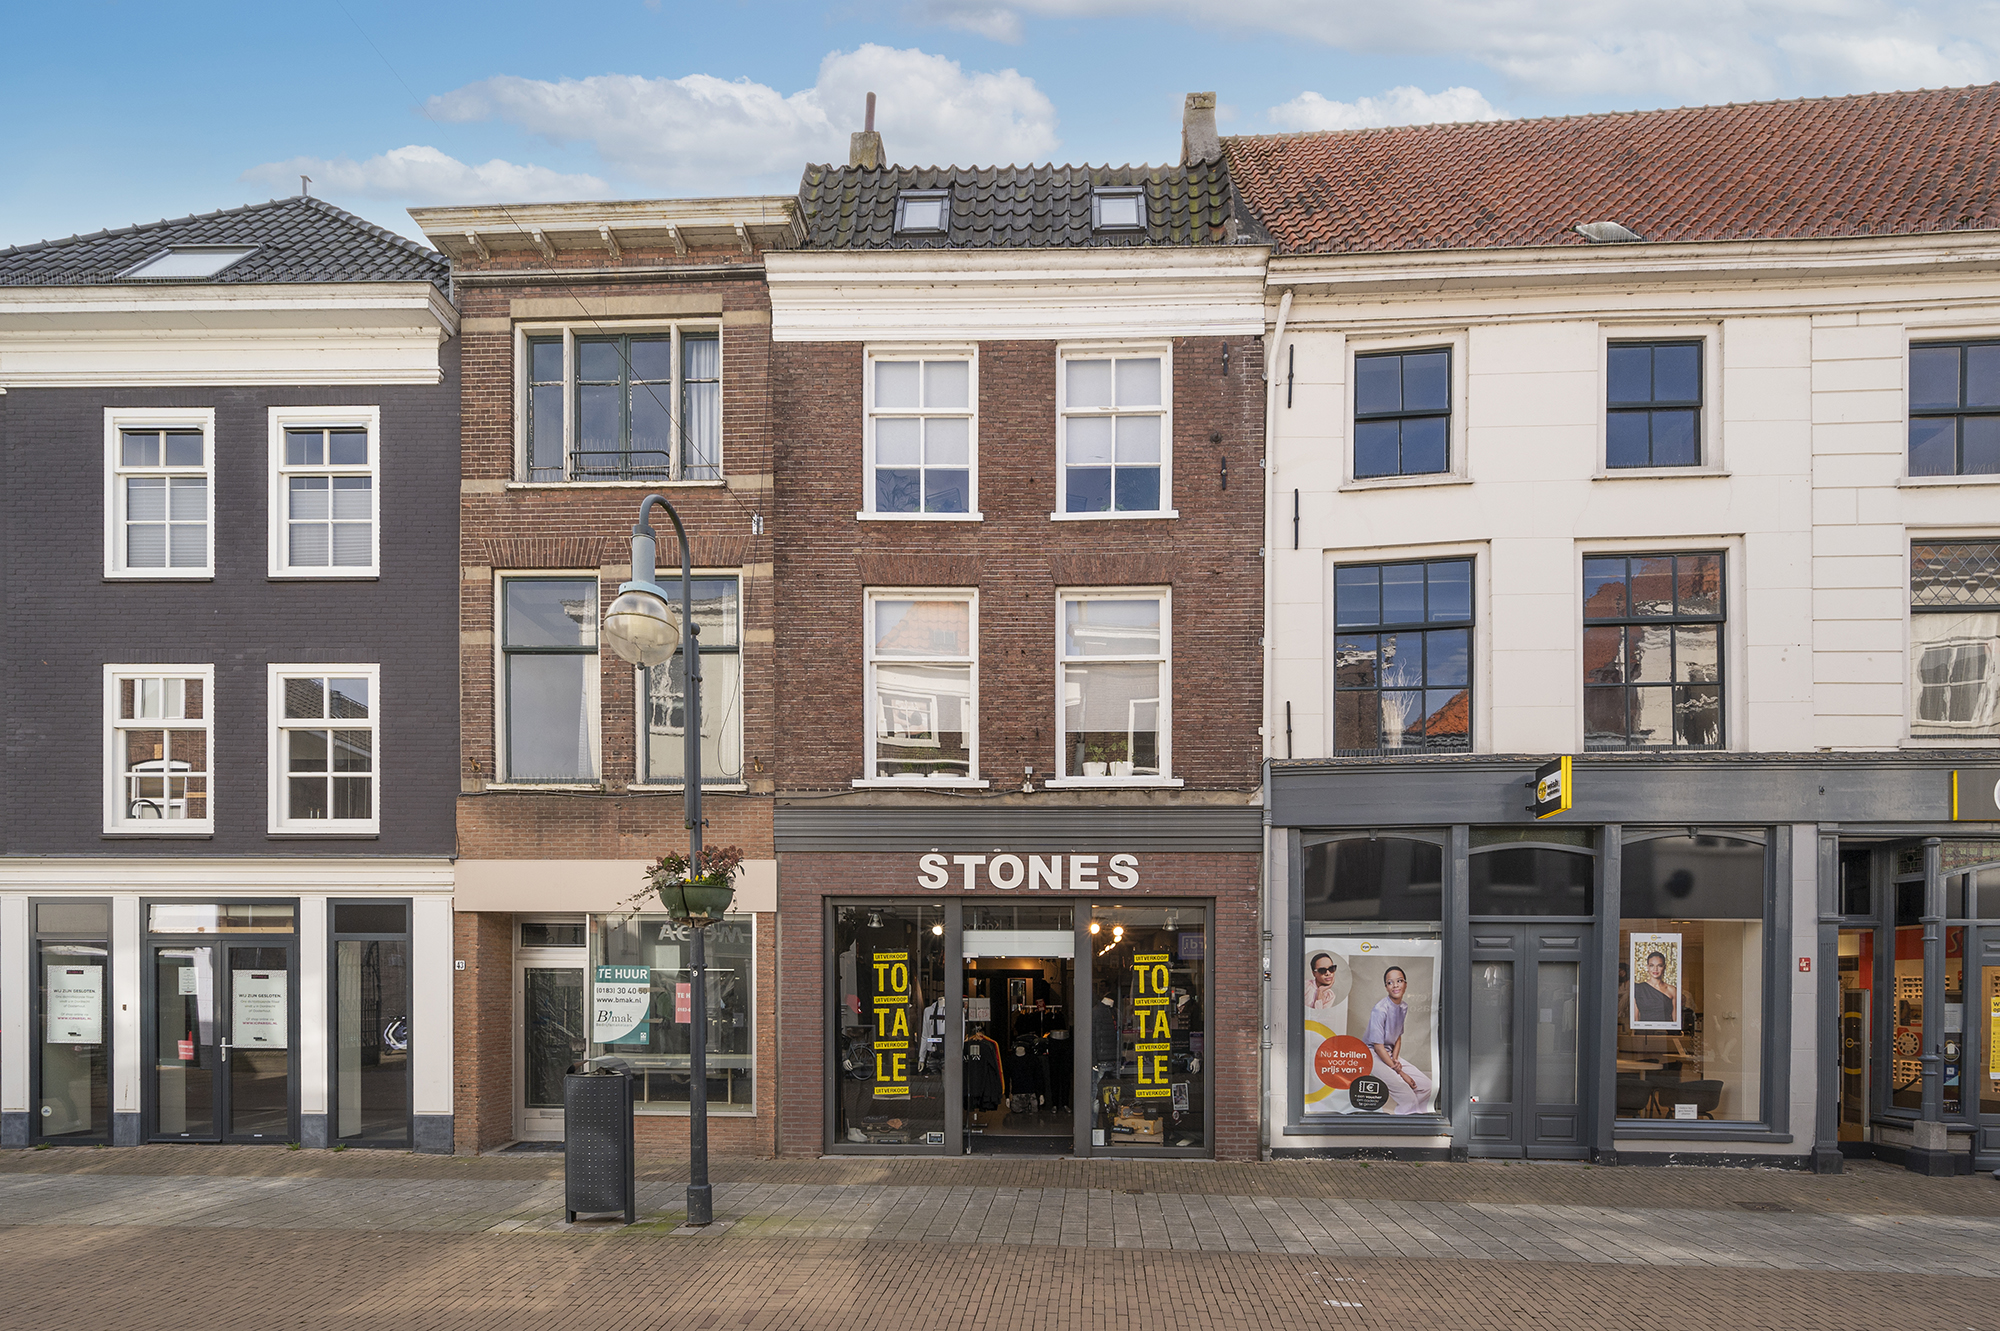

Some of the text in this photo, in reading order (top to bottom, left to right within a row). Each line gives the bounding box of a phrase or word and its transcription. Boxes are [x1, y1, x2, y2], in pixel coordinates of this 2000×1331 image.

[918, 854, 1139, 890] STONES
[598, 968, 648, 979] TE HUUR
[873, 963, 908, 992] TO
[1134, 965, 1169, 994] TO
[874, 1008, 909, 1036] TA
[1134, 1010, 1171, 1038] TA
[876, 1053, 907, 1081] LE
[1138, 1056, 1168, 1084] LE
[1322, 1066, 1339, 1074] prijs
